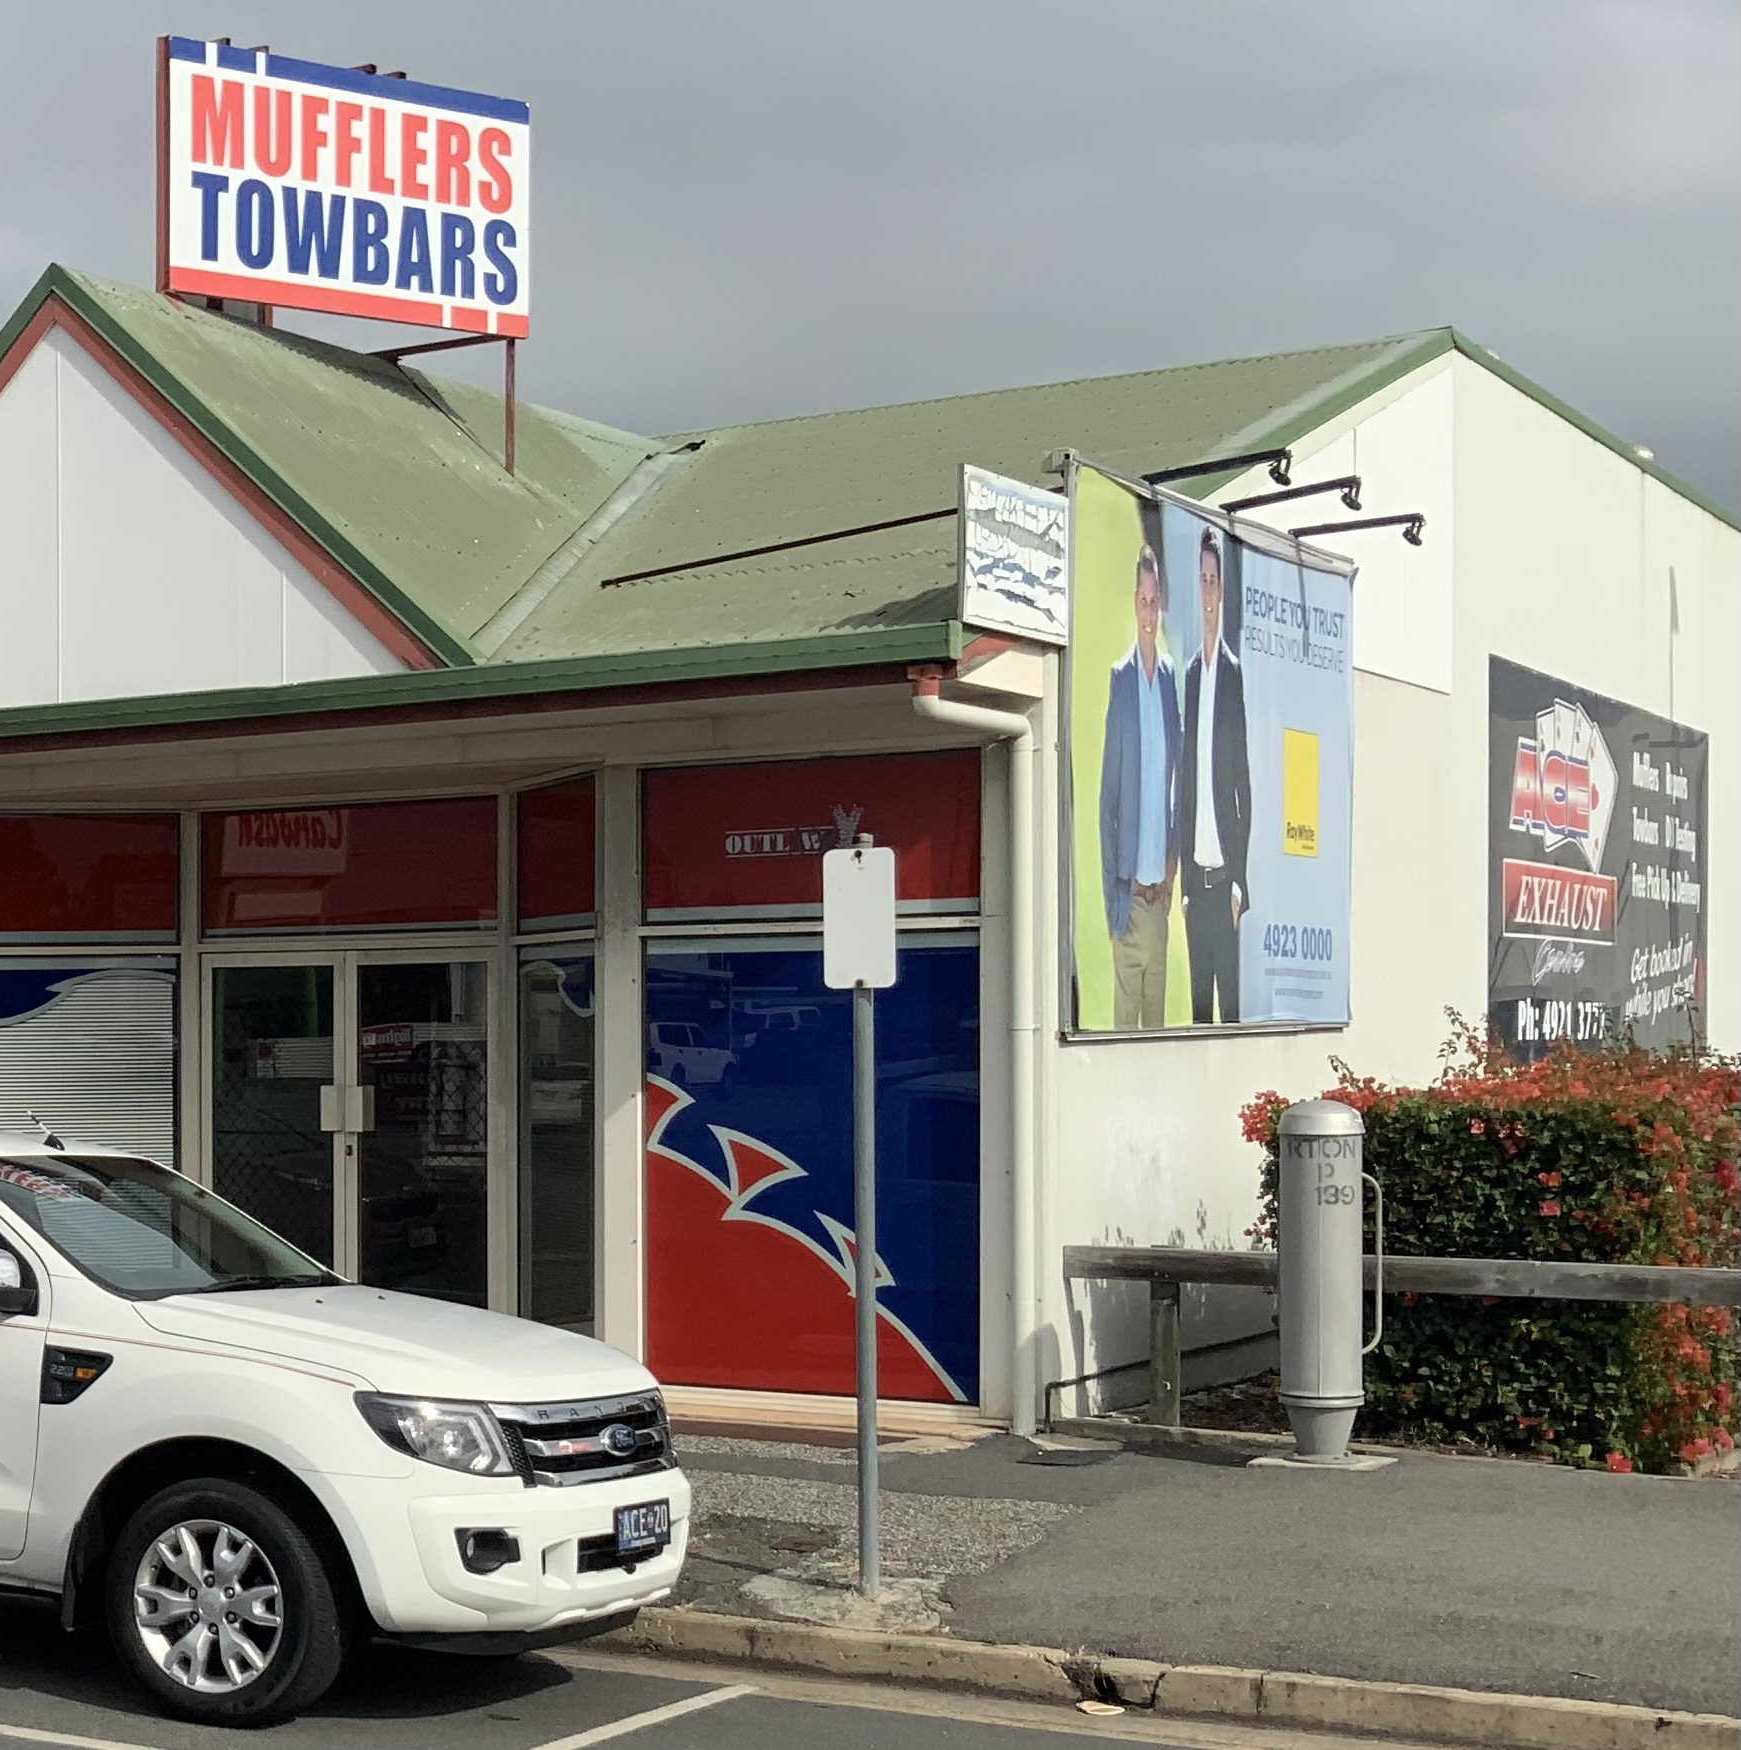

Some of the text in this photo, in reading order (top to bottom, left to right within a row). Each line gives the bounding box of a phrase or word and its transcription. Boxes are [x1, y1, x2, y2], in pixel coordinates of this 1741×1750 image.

[191, 74, 512, 214] MUFFLERS
[191, 171, 518, 305] TOWBARS
[1245, 586, 1345, 639] PEOPLE YOU TRUST
[1244, 624, 1344, 673] RESULTS YOU DESERVE
[1510, 736, 1589, 839] ACE
[725, 832, 823, 854] OUTLW
[1514, 875, 1607, 931] EXHAUST
[1263, 923, 1332, 961] 4923 0000
[1630, 933, 1693, 984] Get booked in
[1517, 997, 1539, 1041] Ph:
[1542, 1000, 1571, 1041] 4921
[1651, 985, 1671, 1025] you
[623, 1504, 668, 1540] ACE 20
